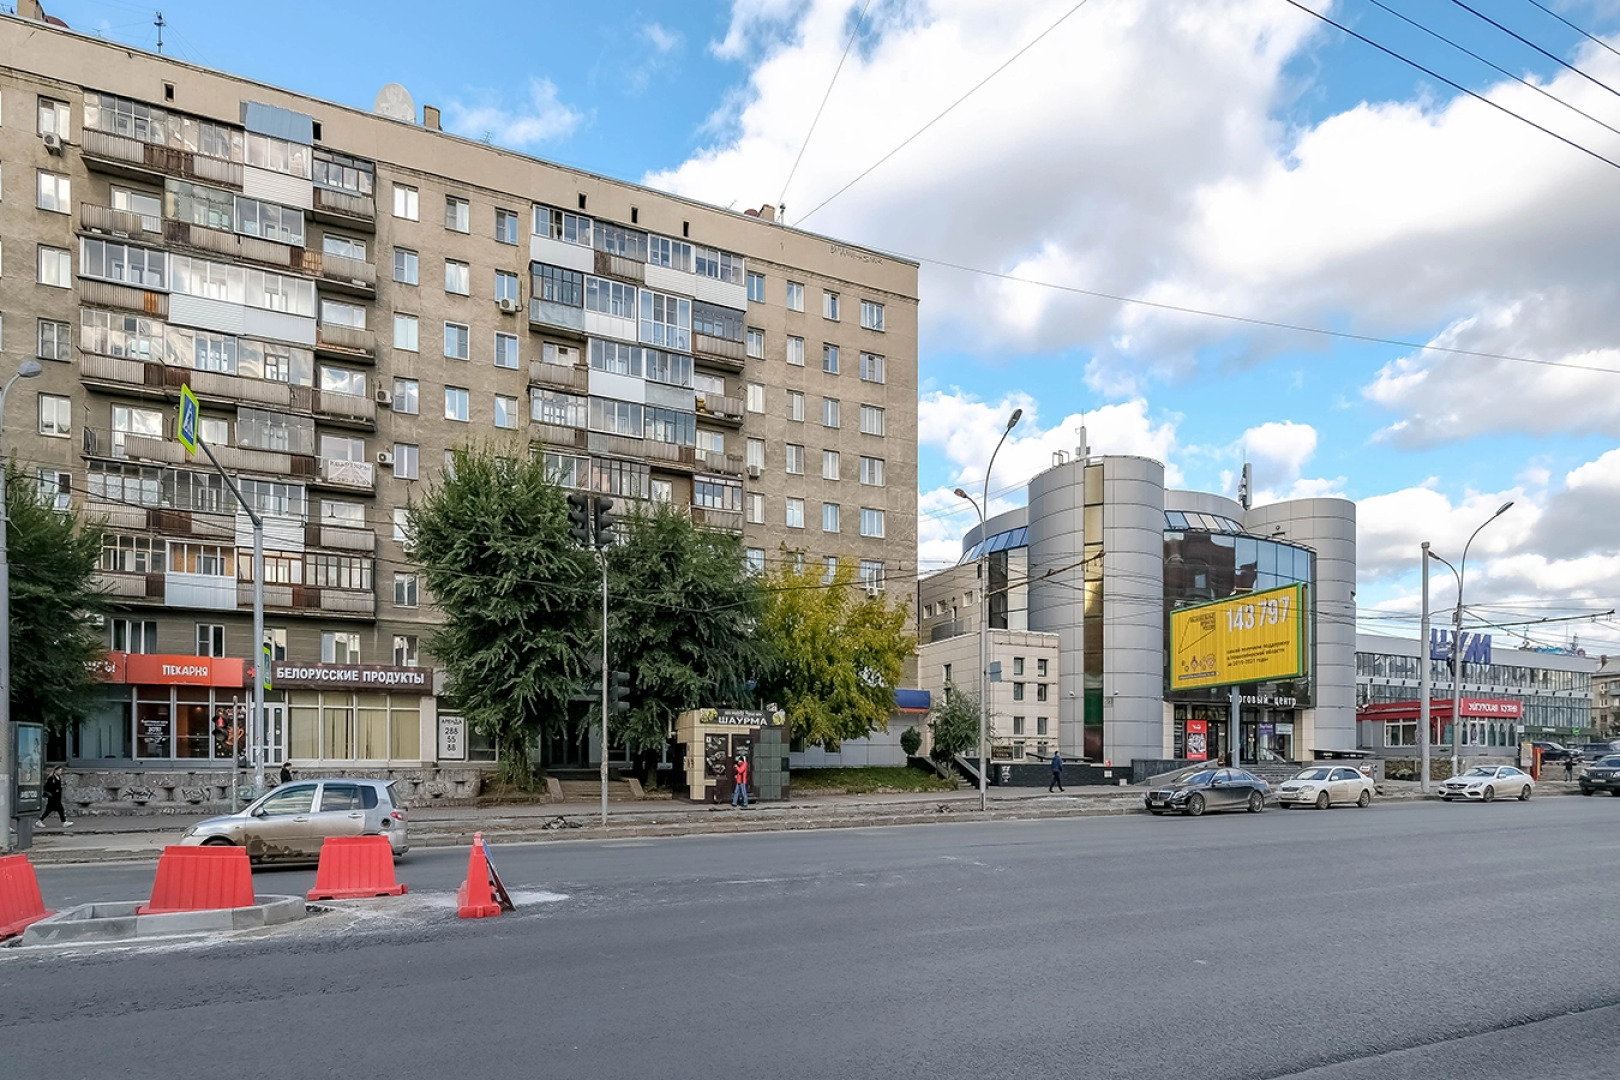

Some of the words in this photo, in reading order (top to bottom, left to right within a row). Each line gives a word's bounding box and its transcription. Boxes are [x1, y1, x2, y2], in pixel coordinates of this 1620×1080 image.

[1226, 604, 1255, 632] 143
[1258, 596, 1290, 627] 797
[162, 664, 209, 677] ПЕКАРНЯ
[276, 667, 359, 681] БЕЛОРУССКИЕ
[362, 671, 425, 685] ПРОДУКТЫ
[1274, 695, 1297, 708] центр
[441, 718, 463, 726] АРЕНДА
[718, 716, 768, 726] ШАУРМА
[447, 735, 457, 744] 55
